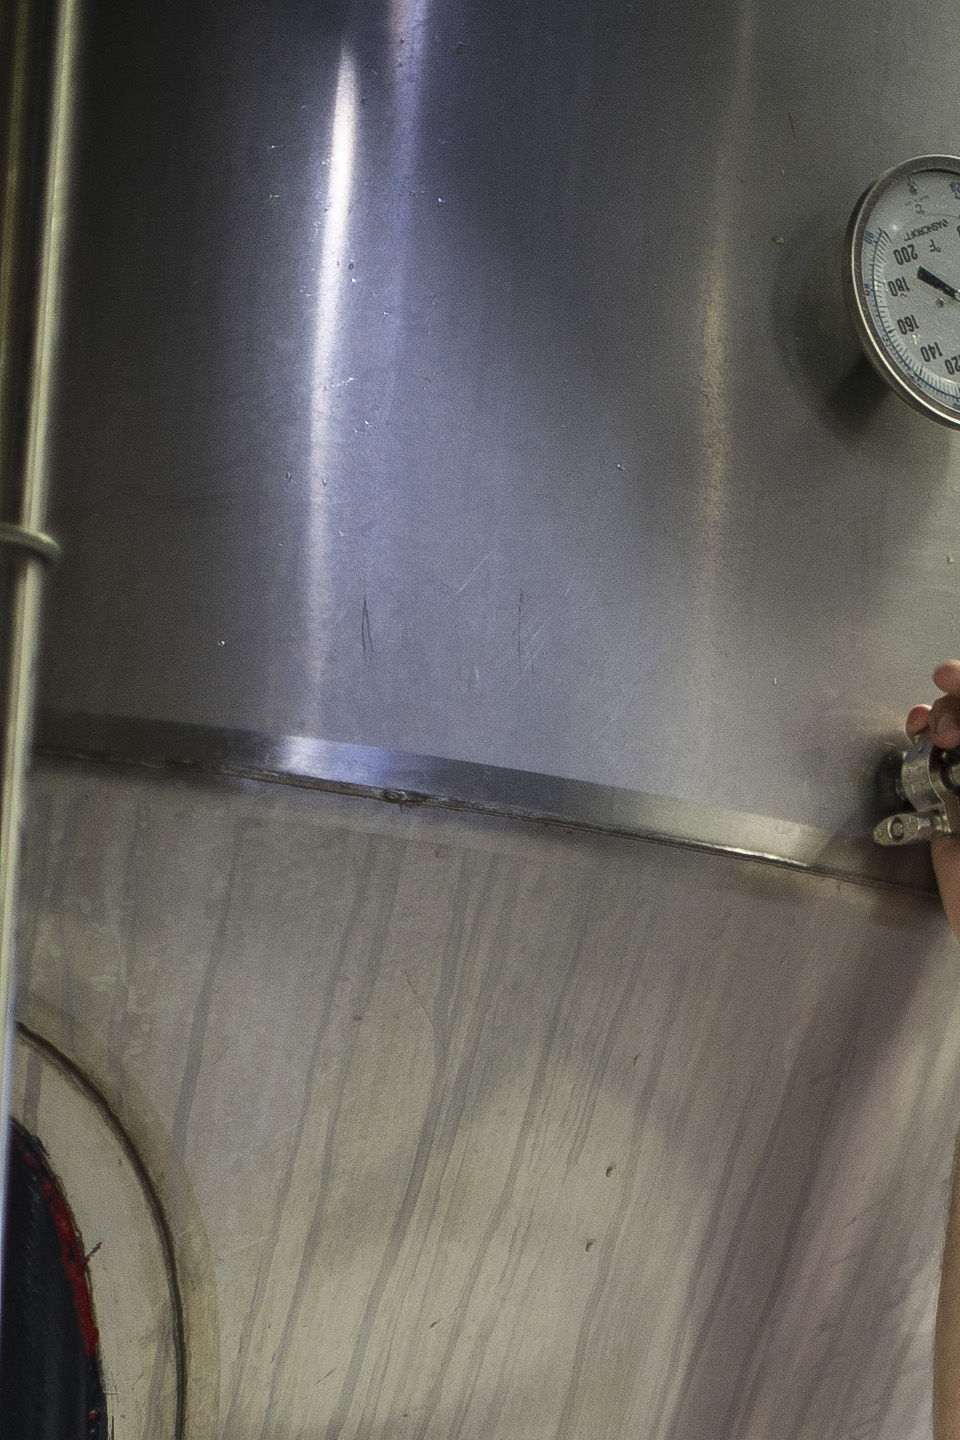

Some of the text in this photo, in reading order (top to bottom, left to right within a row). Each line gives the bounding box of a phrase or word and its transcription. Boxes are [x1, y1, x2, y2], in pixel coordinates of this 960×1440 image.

[904, 219, 944, 241] ASHCROFT
[893, 244, 918, 265] 200
[888, 276, 910, 296] 180
[897, 314, 920, 335] 160
[920, 342, 943, 362] 140
